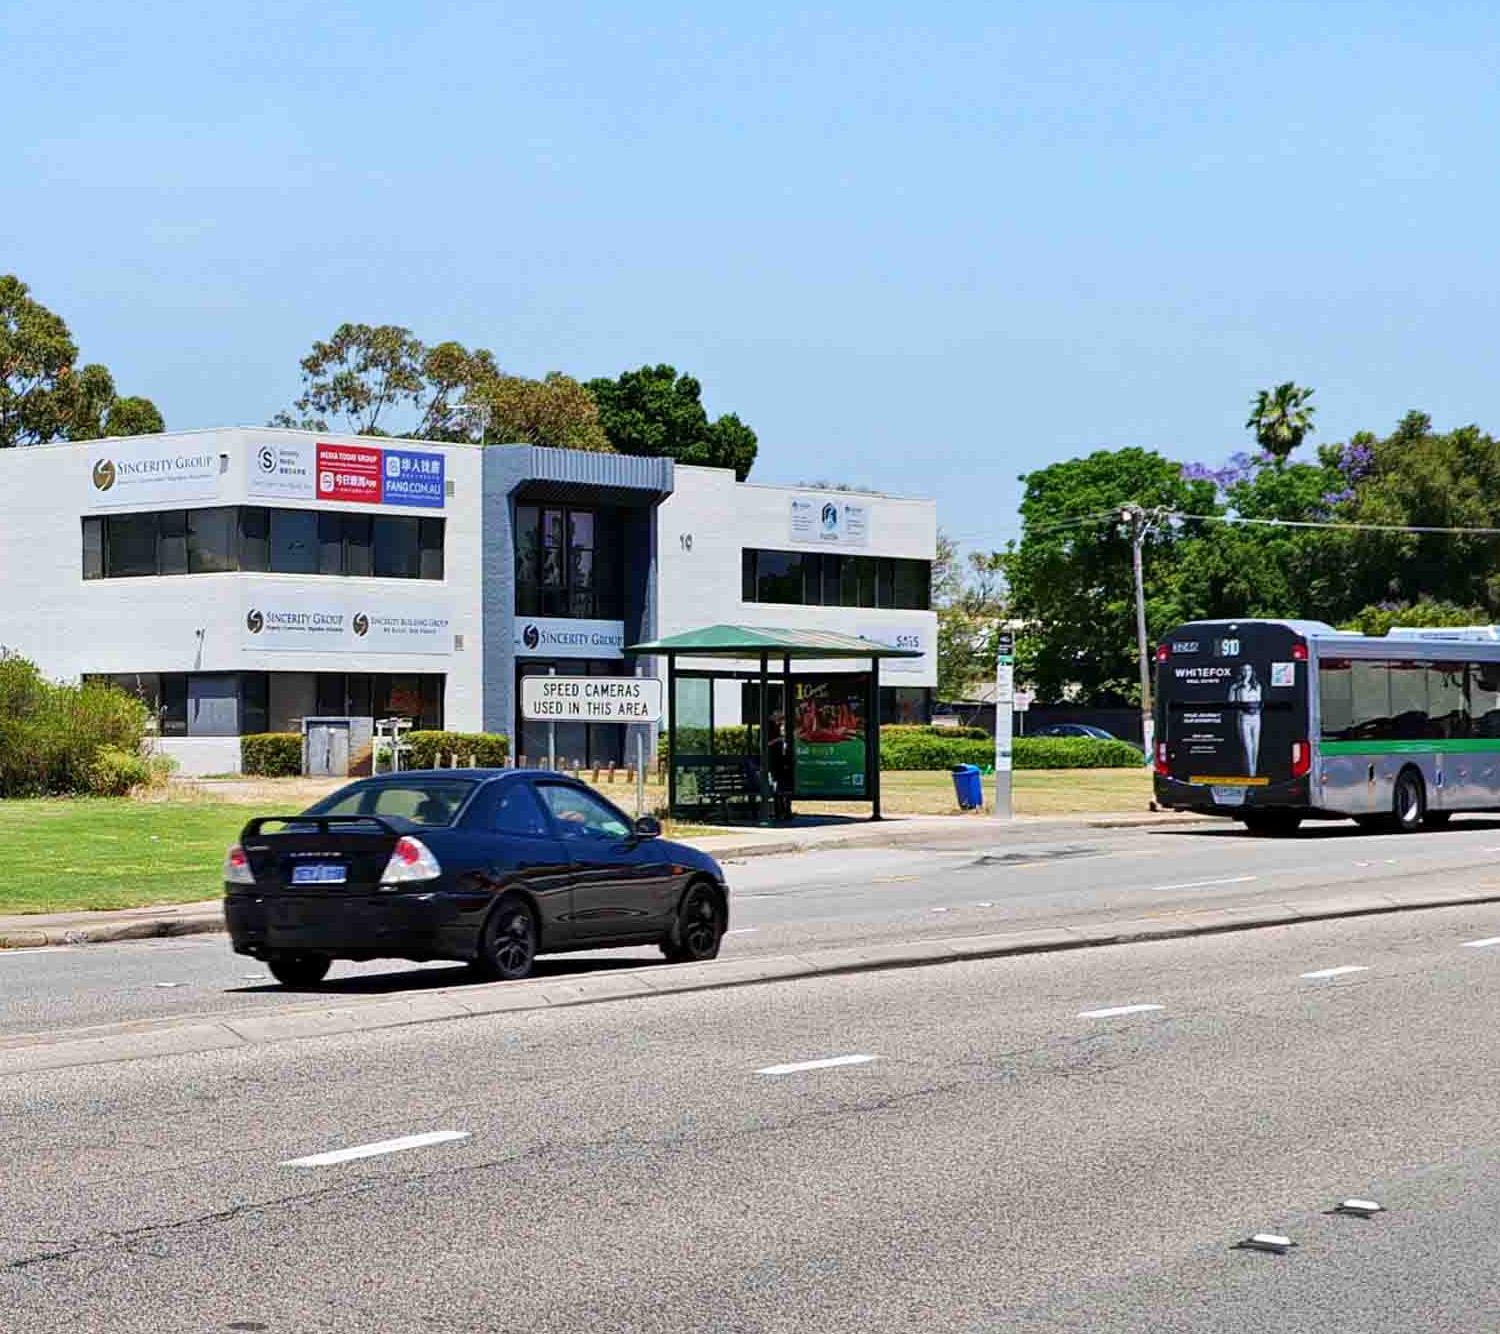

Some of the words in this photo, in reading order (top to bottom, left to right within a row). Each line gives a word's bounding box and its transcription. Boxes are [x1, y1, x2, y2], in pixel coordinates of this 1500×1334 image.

[117, 458, 173, 475] SINCERITY
[175, 454, 214, 469] GROUP
[265, 611, 311, 625] SINCERITY
[312, 612, 344, 626] GROUP
[540, 631, 588, 646] SINCERITY
[591, 632, 624, 647] GROUP
[1175, 667, 1232, 678] WHITEFOX
[543, 682, 579, 697] SPEED
[584, 683, 641, 698] CAMERAS
[533, 701, 563, 715] USED
[568, 701, 580, 715] IN
[587, 701, 612, 716] THIS
[617, 702, 649, 716] AREA
